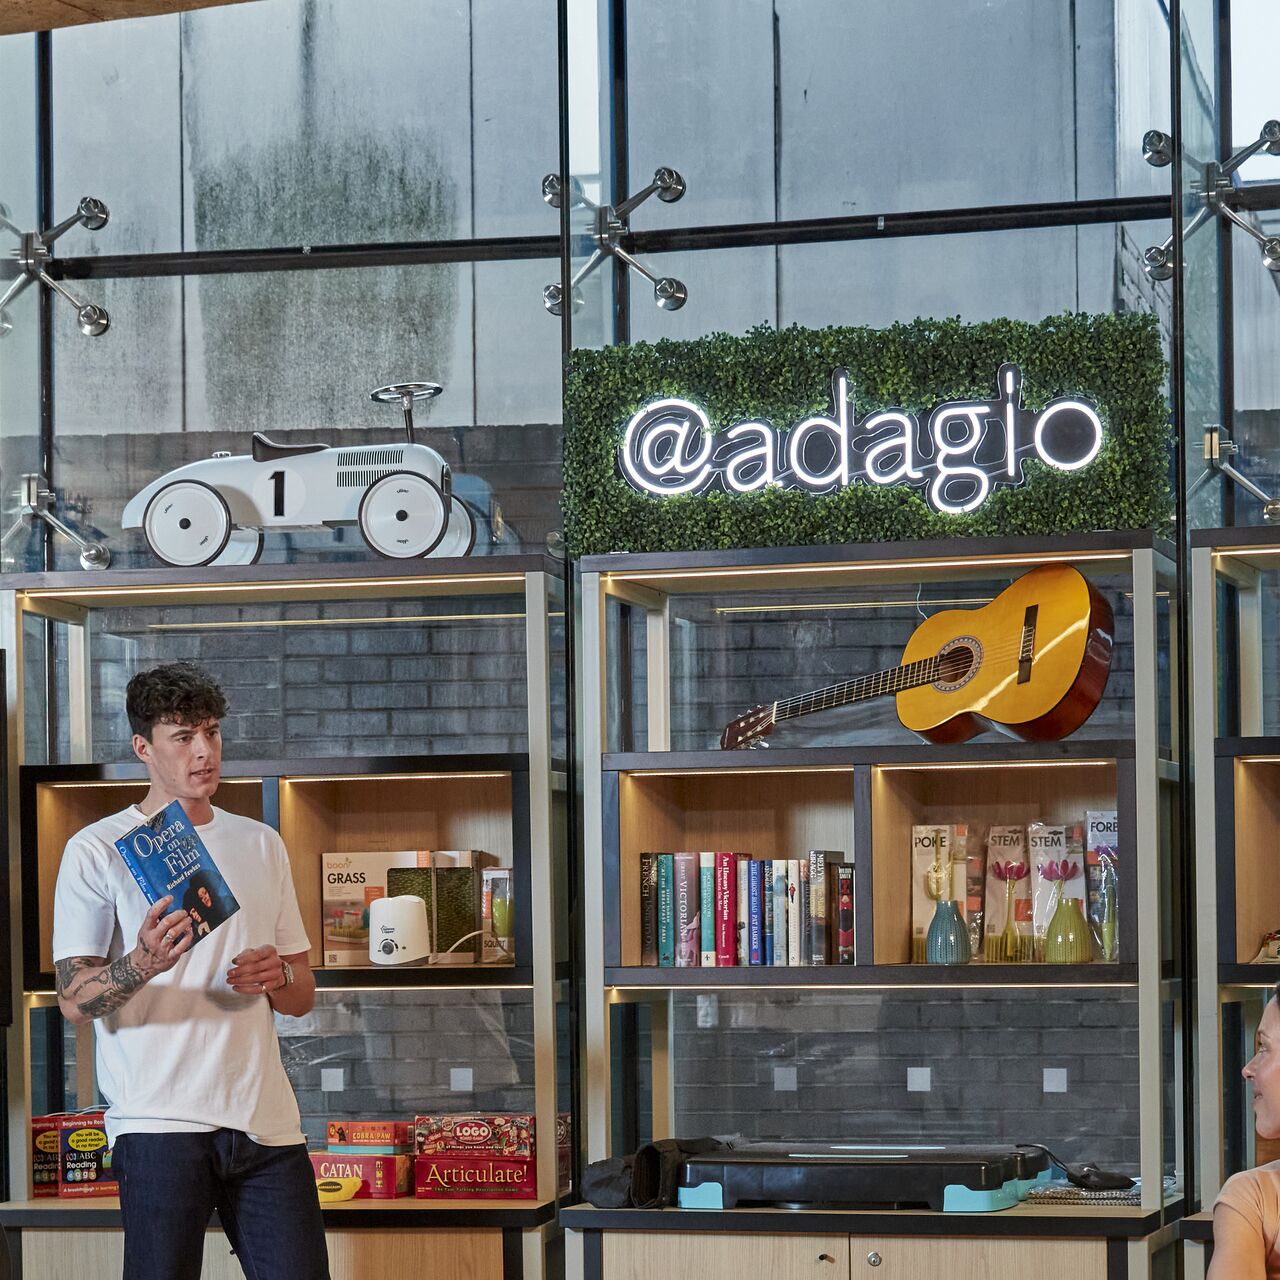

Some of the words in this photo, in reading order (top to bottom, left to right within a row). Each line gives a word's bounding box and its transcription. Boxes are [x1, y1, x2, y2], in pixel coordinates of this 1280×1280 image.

[622, 370, 1104, 515] @adagio
[268, 470, 286, 517] 1
[133, 820, 185, 858] Opera
[167, 838, 180, 851] on
[991, 835, 1020, 847] STEM
[1031, 836, 1062, 848] STEM
[163, 848, 201, 877] Film
[722, 855, 730, 866] An
[166, 873, 185, 891] Richard
[184, 863, 201, 878] Fawkes
[327, 872, 366, 884] GRASS
[642, 859, 652, 897] FRENCH
[722, 867, 730, 890] Uneasy
[680, 881, 688, 938] VICTORIAN
[722, 890, 730, 921] Victorian
[63, 1119, 87, 1128] Beginning
[456, 1126, 489, 1137] LOGO
[352, 1132, 375, 1140] COBRA
[376, 1132, 391, 1140] PAW
[79, 1151, 97, 1160] ABC
[66, 1161, 97, 1170] Reading
[320, 1162, 363, 1178] CATAN
[425, 1162, 528, 1188] Articulate!
